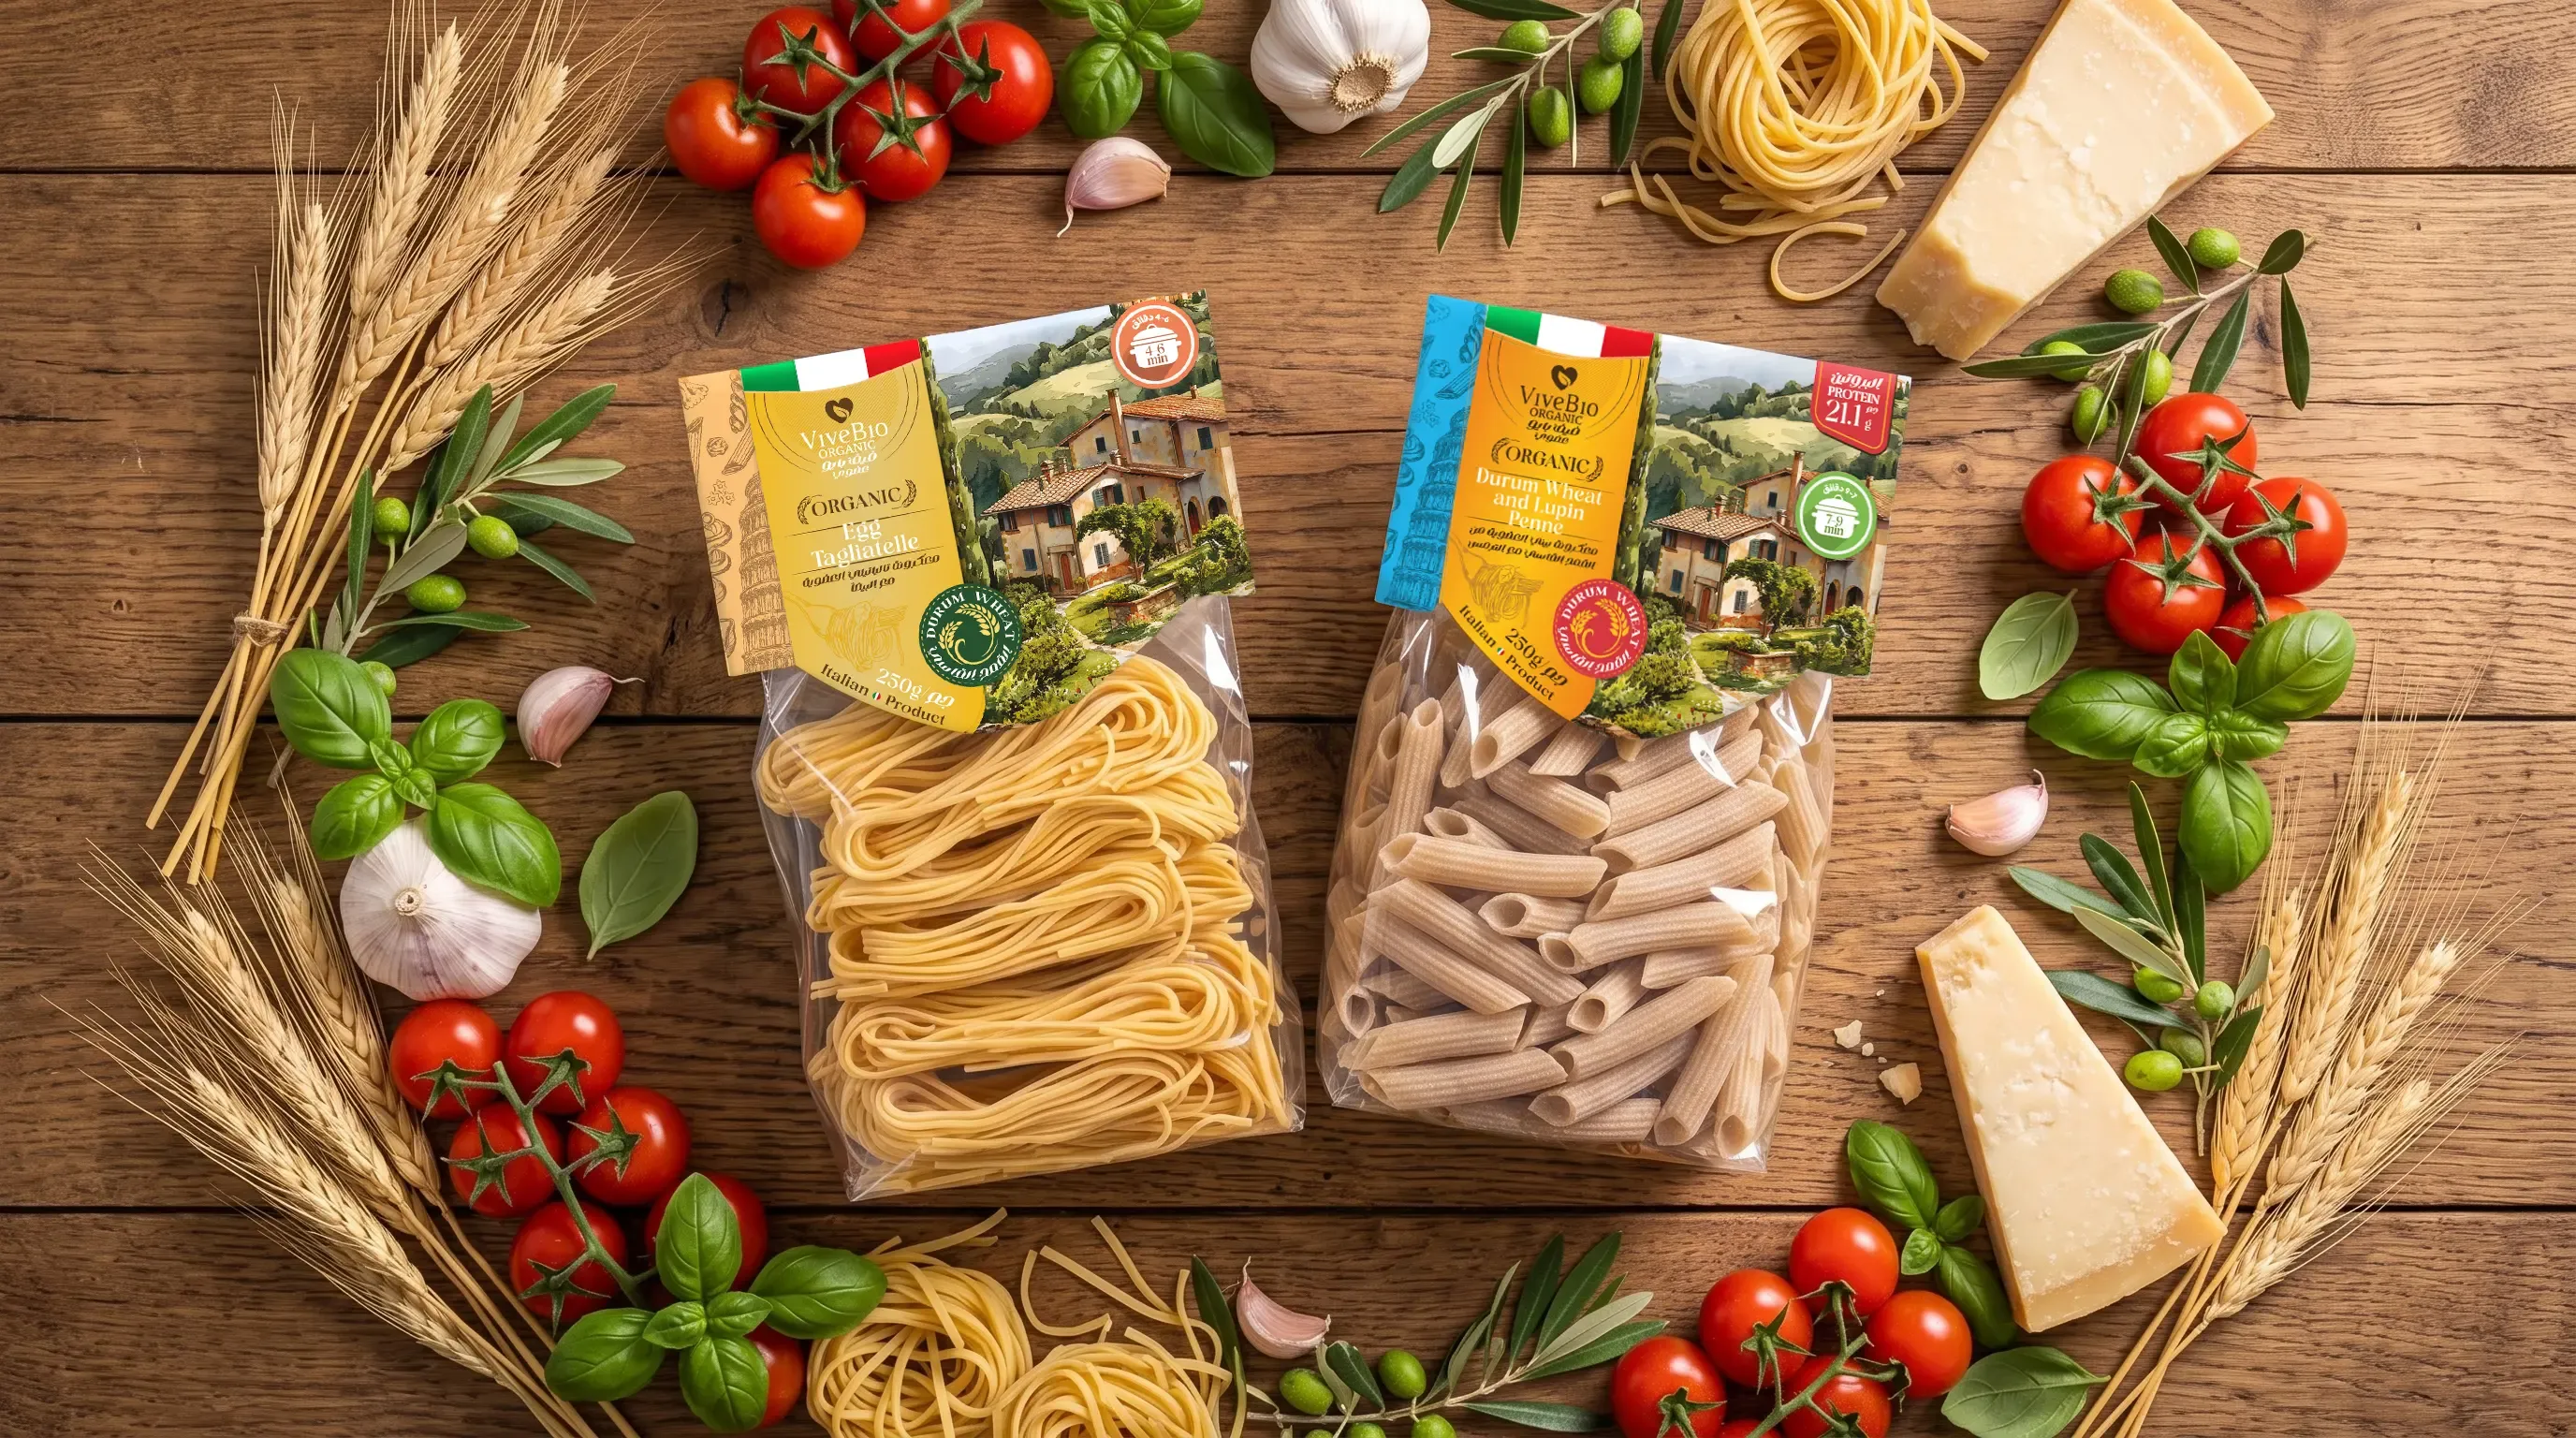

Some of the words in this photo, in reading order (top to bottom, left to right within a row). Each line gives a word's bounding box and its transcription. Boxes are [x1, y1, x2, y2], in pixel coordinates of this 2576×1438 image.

[1148, 354, 1168, 365] min
[1830, 373, 1883, 389] البروتين
[1827, 386, 1881, 404] PROTEIN
[1530, 406, 1584, 425] ORGANIC
[1825, 399, 1861, 427] 21.1
[1865, 419, 1872, 431] g
[818, 440, 876, 459] ORGANIC
[1505, 446, 1589, 474] ORGANIC
[1475, 466, 1539, 494] Durum
[1544, 479, 1603, 506] Wheat
[811, 487, 902, 517] ORGANIC
[1494, 491, 1530, 510] and
[1534, 496, 1586, 521] Lupin
[842, 519, 882, 542] Egg
[1469, 526, 1486, 536] من
[1486, 528, 1529, 541] العضوية
[1509, 510, 1563, 536] Penne
[1823, 524, 1844, 536] min
[811, 534, 919, 568] Tagliatelle
[1524, 549, 1565, 565] القاسي
[1565, 557, 1596, 569] القمح
[802, 571, 846, 588] العضوية
[879, 577, 896, 590] مع
[927, 592, 966, 638] DURUM
[975, 592, 1015, 640] WHEAT
[1561, 586, 1608, 620] DURUM
[1617, 591, 1640, 650] WHEAT
[1458, 605, 1498, 648] Italian
[1505, 654, 1556, 701] Product
[1558, 625, 1595, 671] القاسي
[928, 646, 977, 680] القاسي
[979, 644, 1013, 682] القمح
[1595, 649, 1632, 674] القمح
[820, 663, 870, 697] Italian
[886, 695, 945, 725] Product
